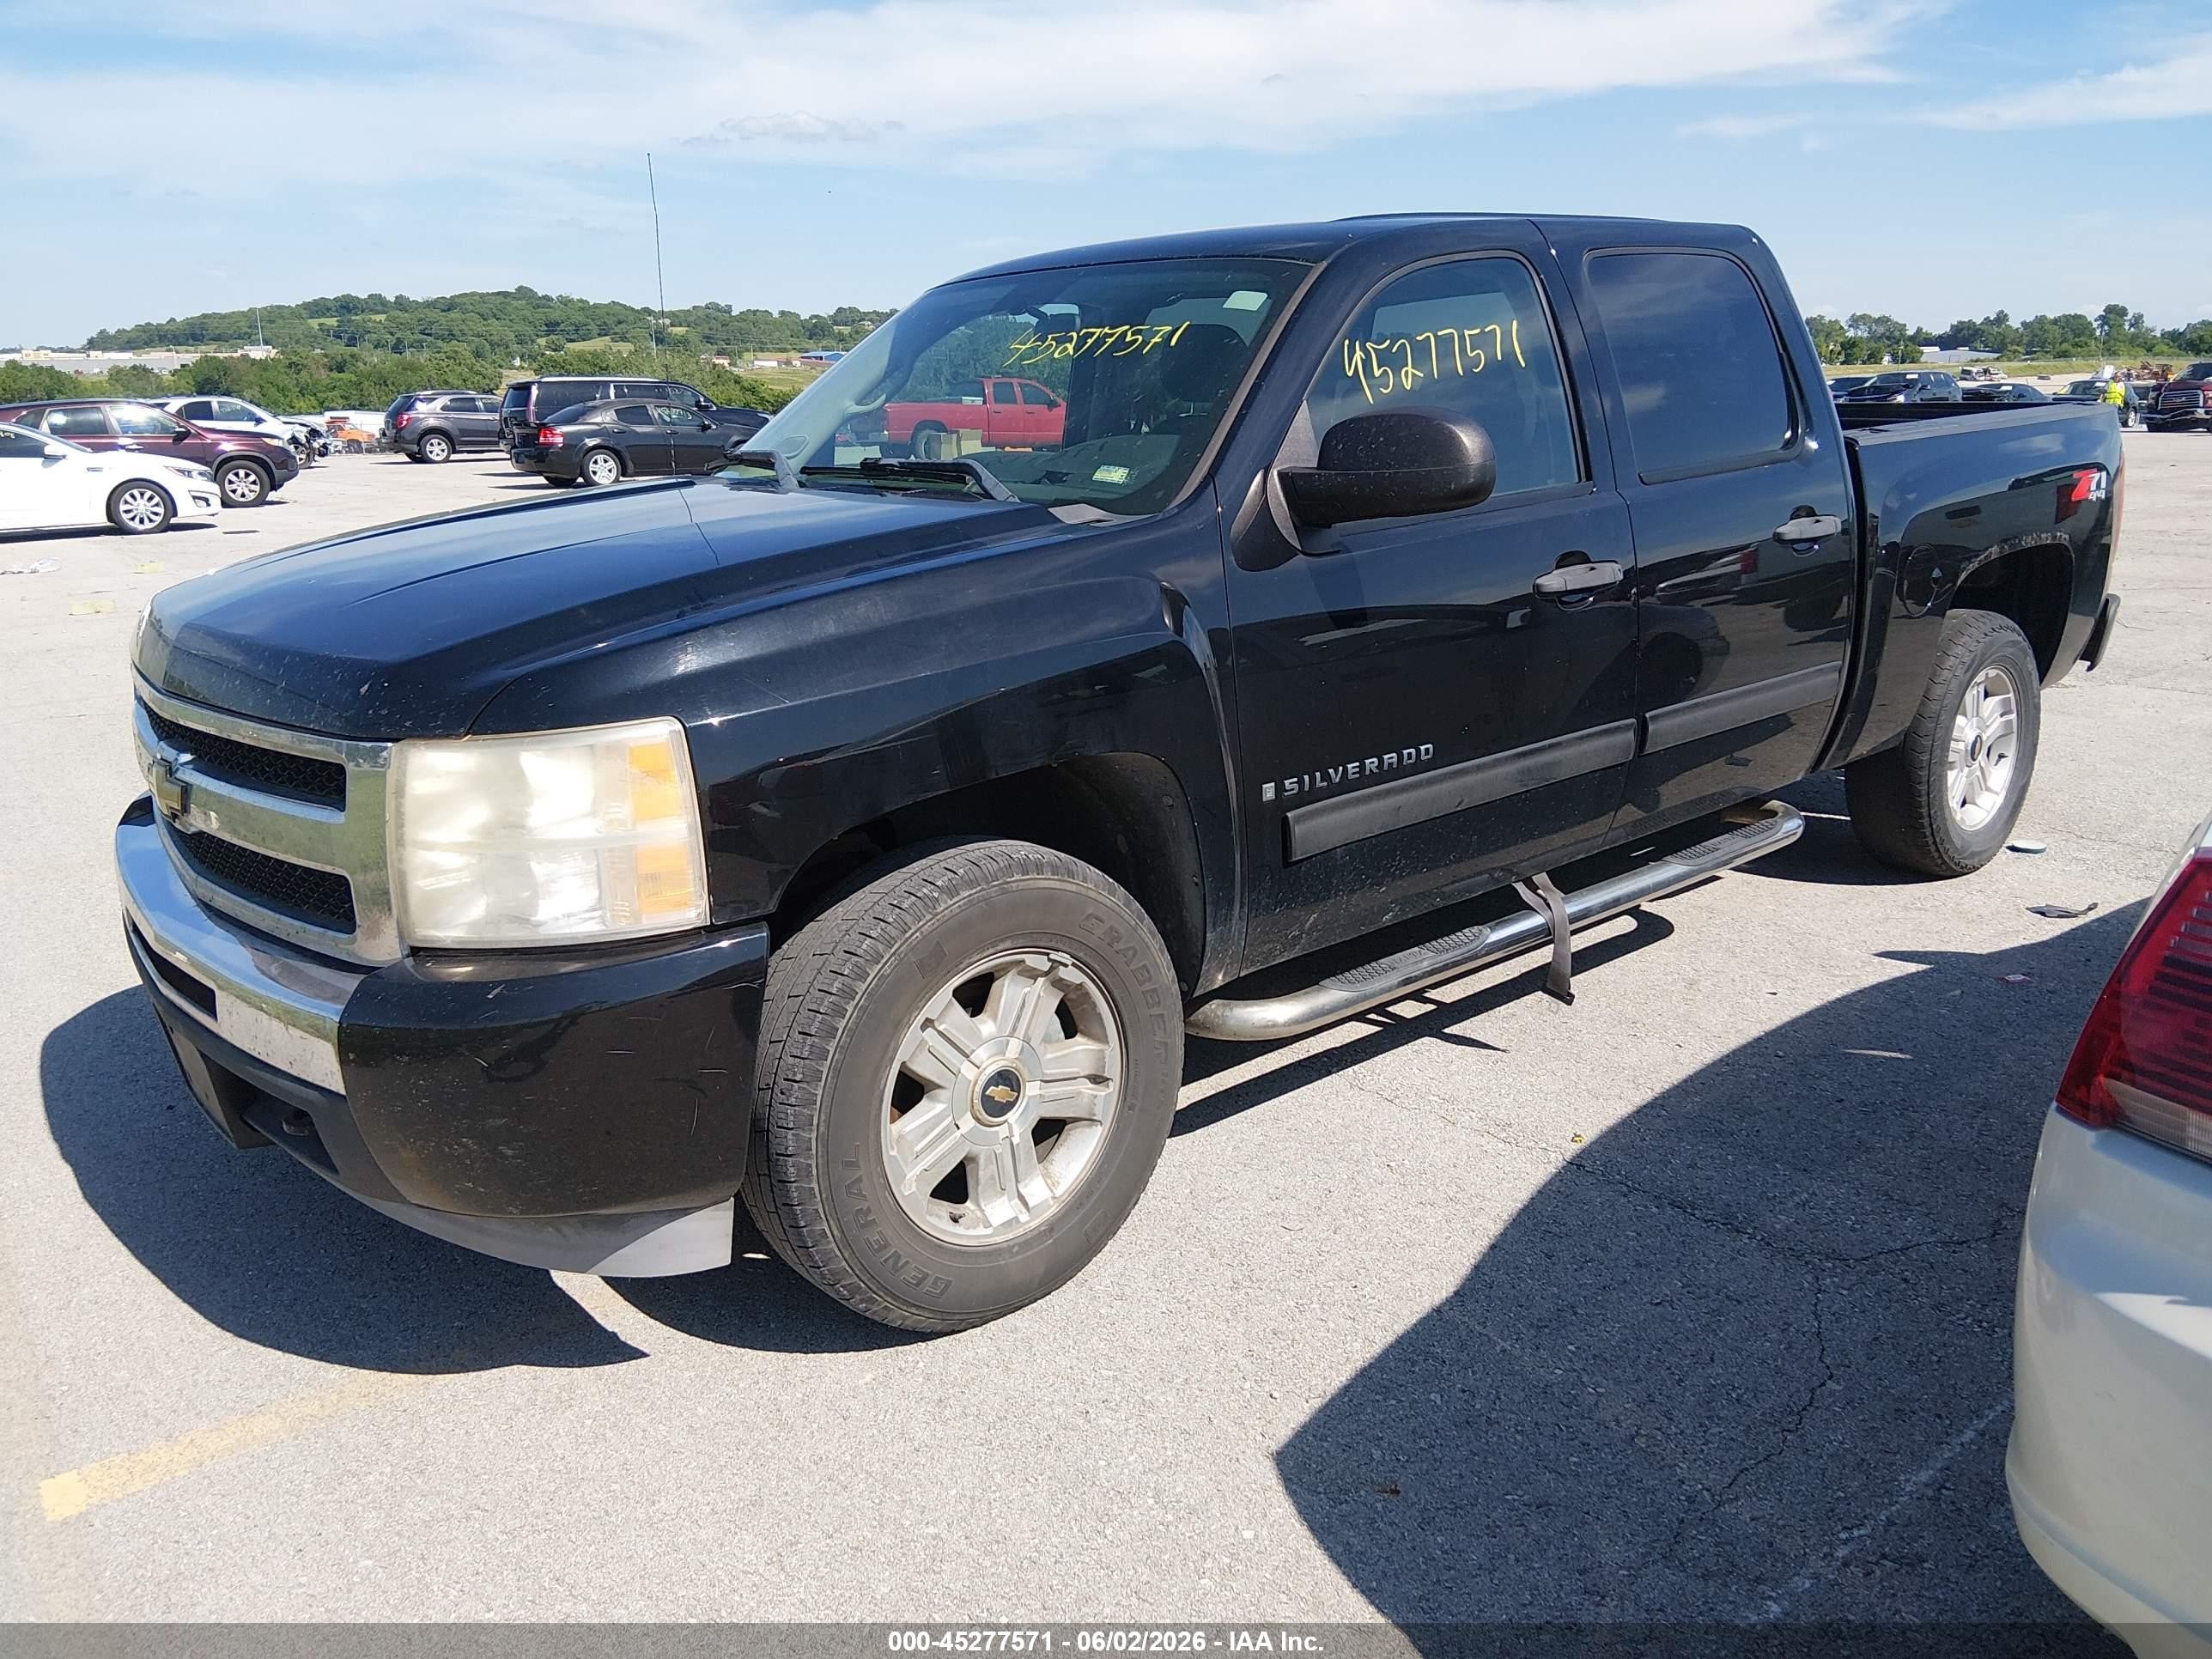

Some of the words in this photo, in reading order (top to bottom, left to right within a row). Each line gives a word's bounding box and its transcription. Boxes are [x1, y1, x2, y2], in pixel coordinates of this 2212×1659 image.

[1002, 320, 1190, 368] 45277571
[1344, 319, 1526, 405] 45277571
[2071, 468, 2107, 502] Z71
[1283, 743, 1434, 797] SILVERADO
[841, 1142, 953, 1300] GENERAL
